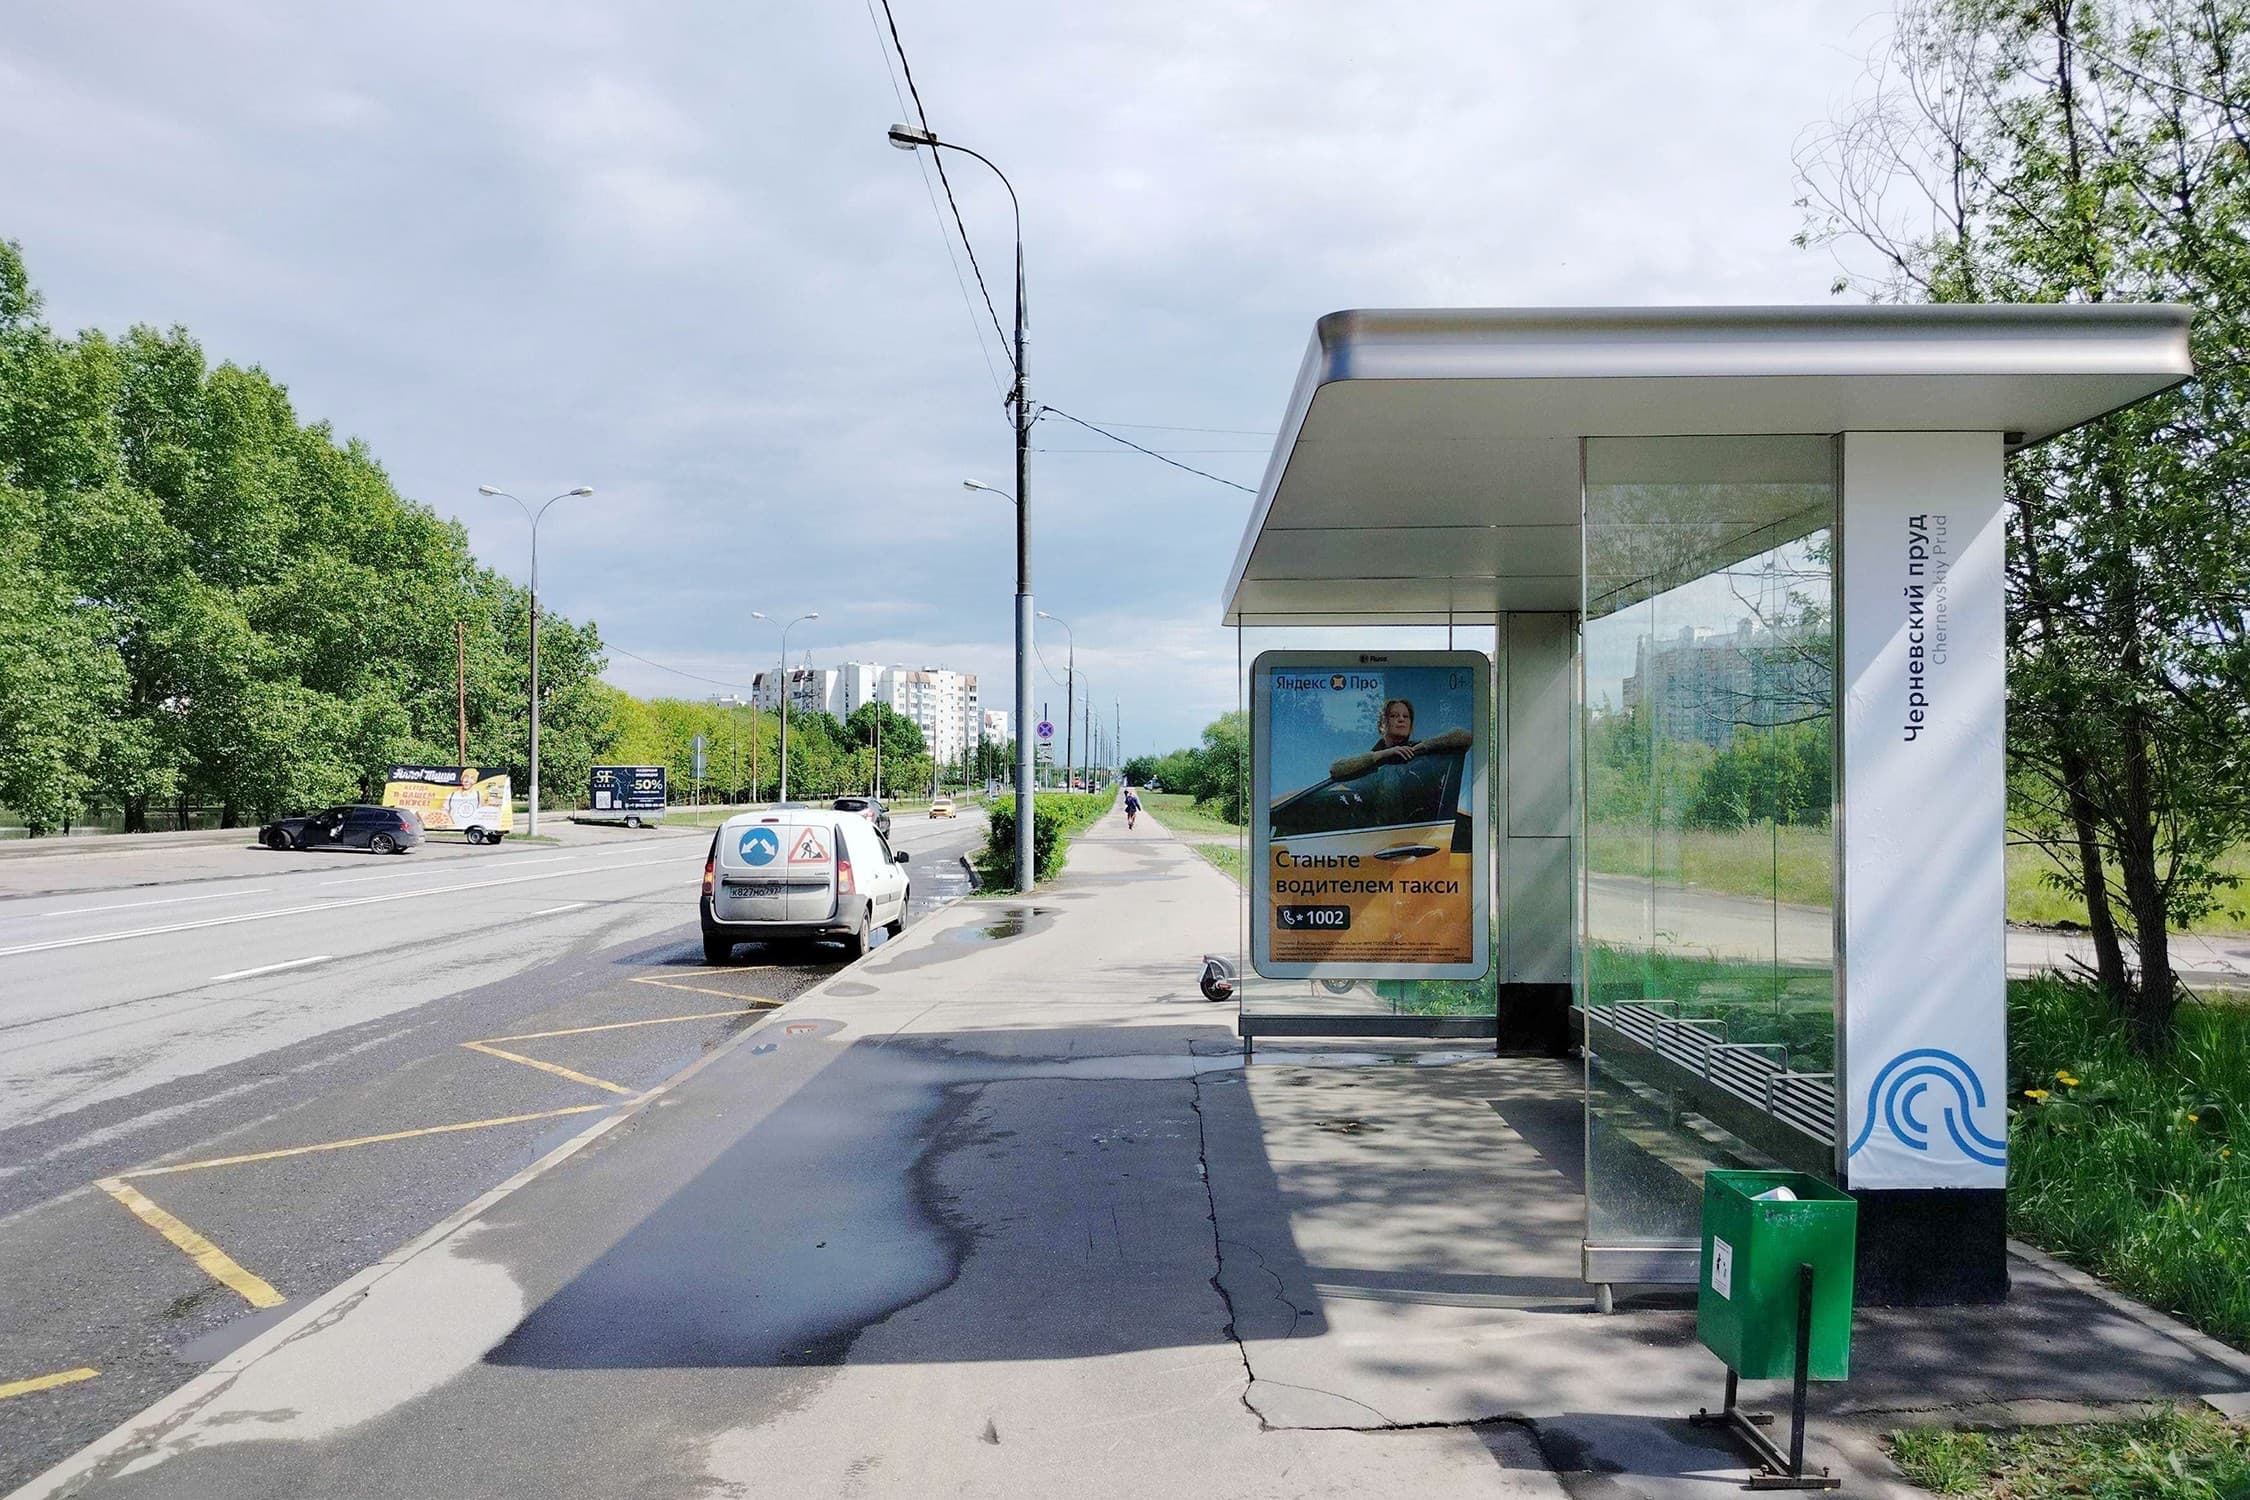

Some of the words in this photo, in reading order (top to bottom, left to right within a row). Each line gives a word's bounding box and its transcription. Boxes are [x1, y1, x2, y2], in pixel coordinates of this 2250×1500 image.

[1908, 514, 1929, 576] пруд
[1932, 514, 1947, 555] Prud
[1932, 559, 1950, 665] Chernevskiy
[1904, 585, 1929, 742] Черневский
[1276, 675, 1327, 691] Яндекс
[1350, 676, 1378, 691] Про
[629, 779, 663, 790] -50%
[1275, 850, 1360, 868] Станьте
[1276, 880, 1393, 896] водителем
[1400, 880, 1459, 894] такси
